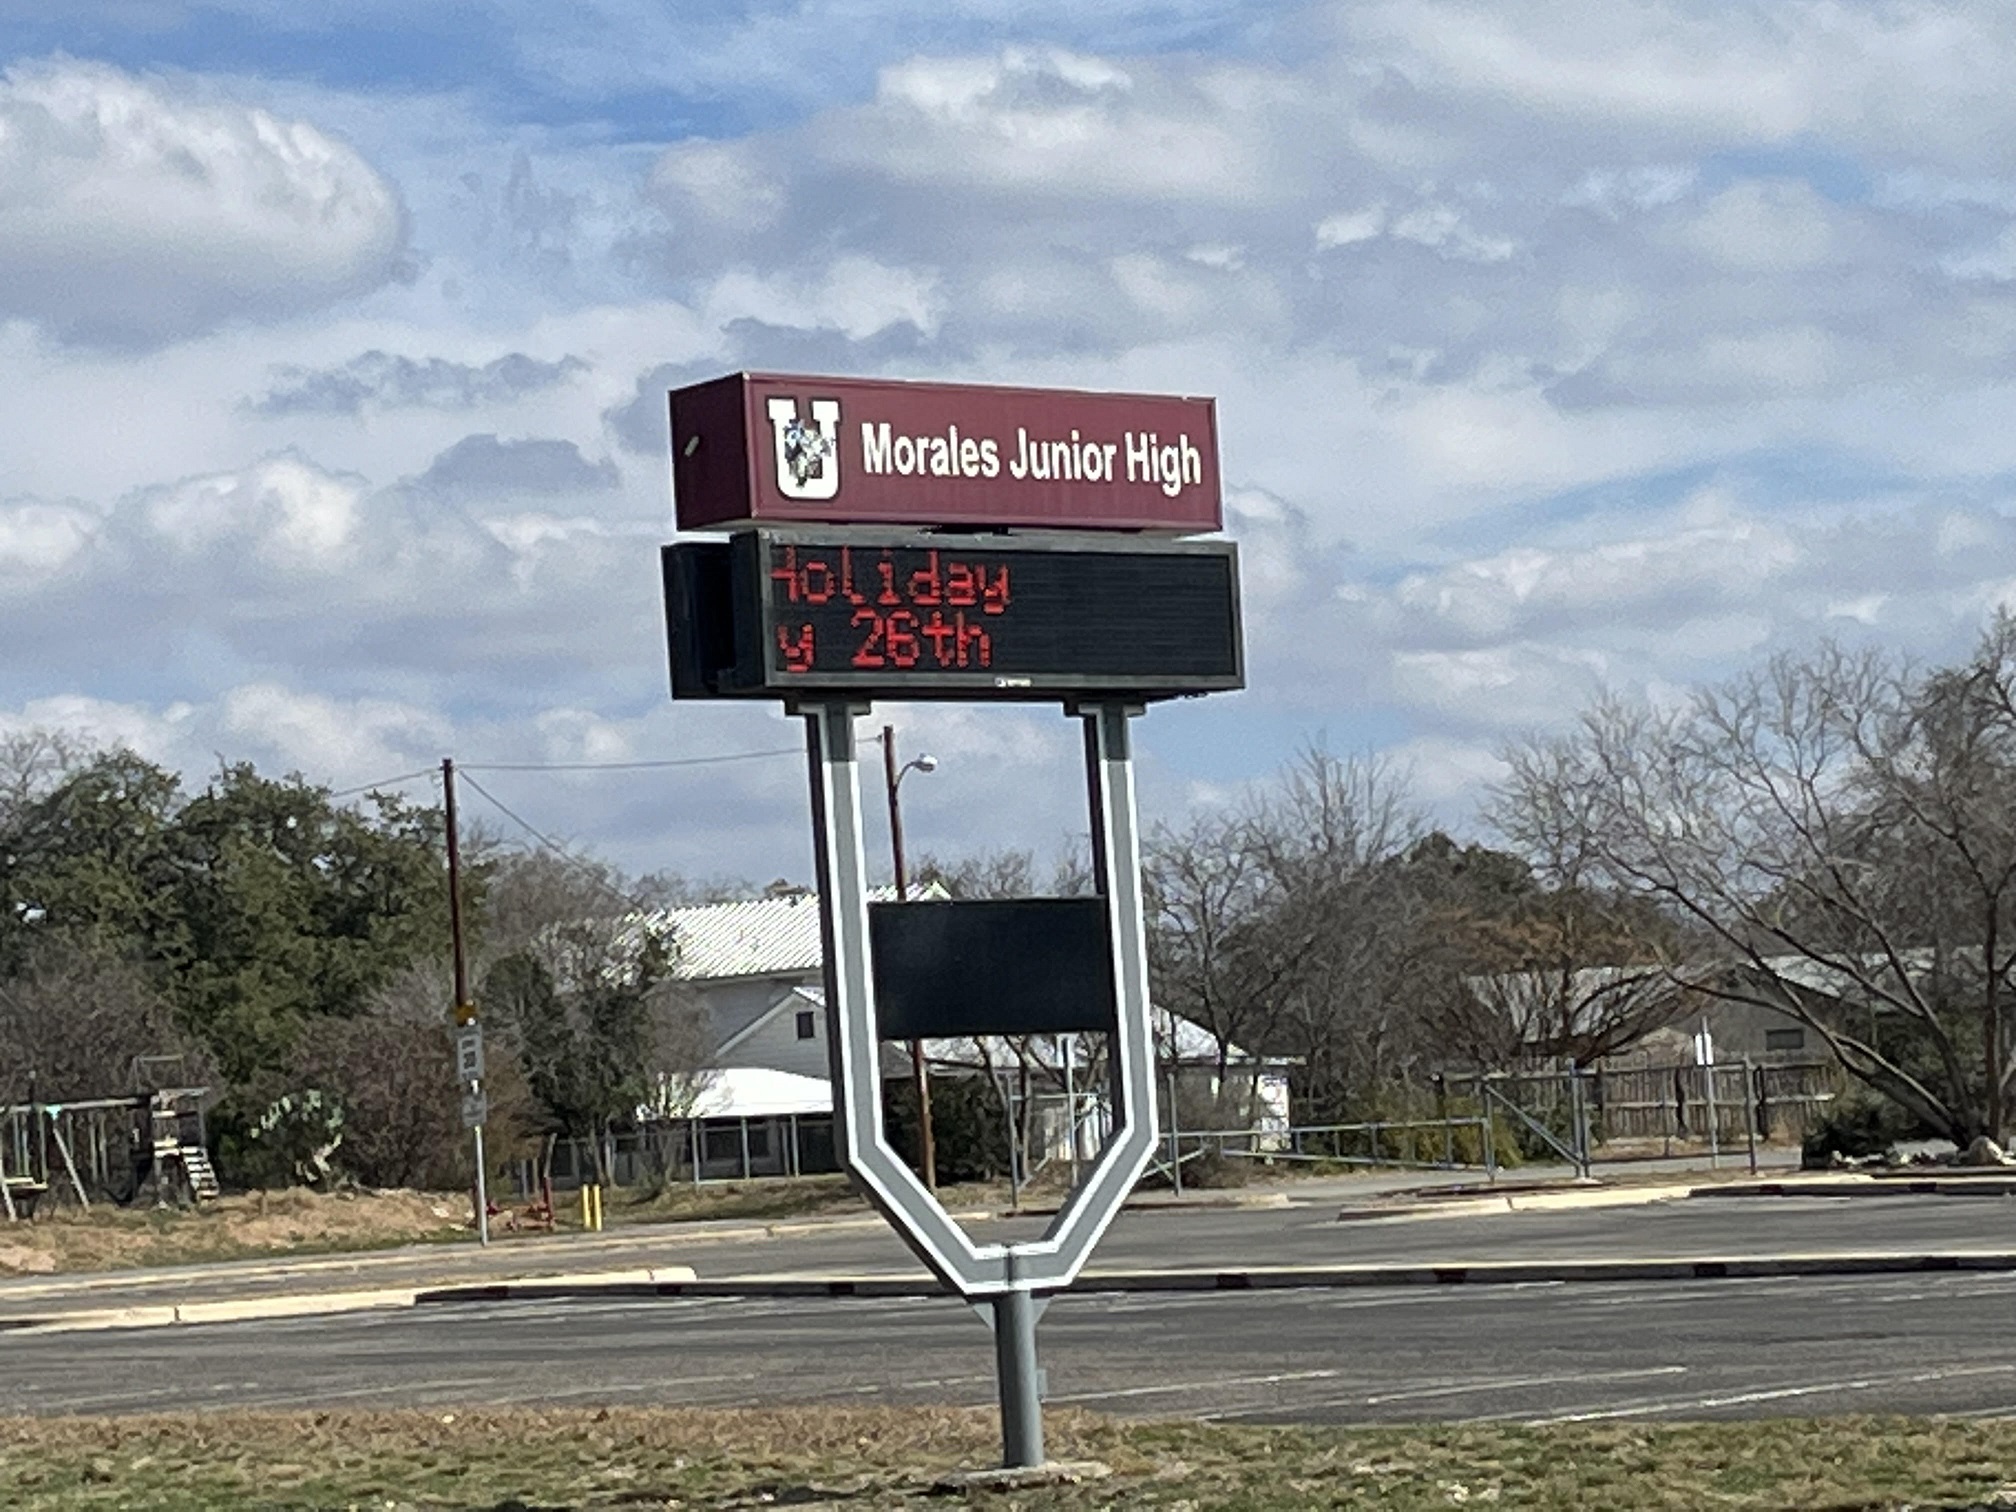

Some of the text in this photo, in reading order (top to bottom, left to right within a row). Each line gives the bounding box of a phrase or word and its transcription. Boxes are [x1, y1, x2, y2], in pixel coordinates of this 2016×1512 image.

[767, 399, 840, 499] U
[862, 422, 1201, 497] Morales Junior High
[778, 609, 991, 672] y 26th
